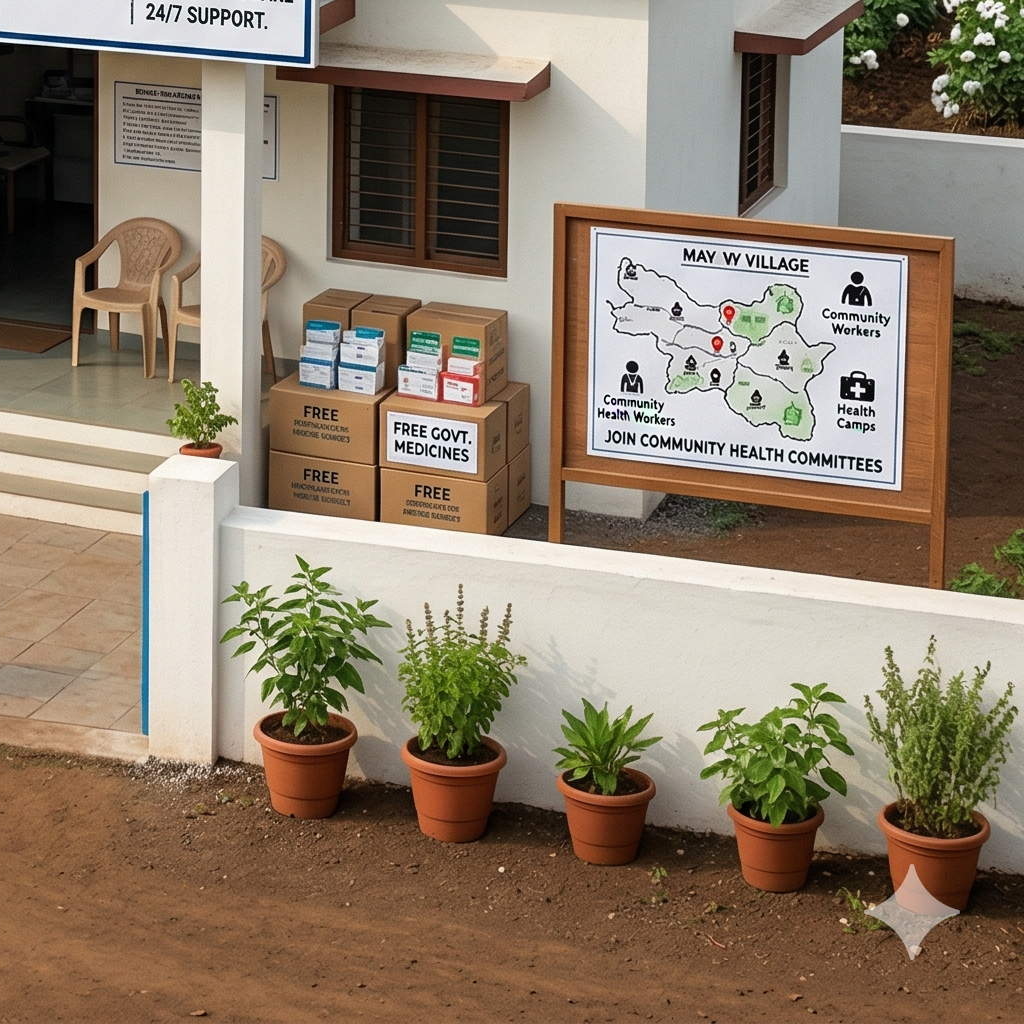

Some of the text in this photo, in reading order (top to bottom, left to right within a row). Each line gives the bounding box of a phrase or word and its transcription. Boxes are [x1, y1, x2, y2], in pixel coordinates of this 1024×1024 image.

[146, 3, 267, 29] 24/7 SUPPORT.
[684, 248, 715, 263] MAY
[745, 254, 809, 273] VILLAGE
[822, 308, 890, 327] Community
[832, 323, 880, 338] Workers
[603, 395, 664, 413] Community
[838, 404, 875, 417] Health
[304, 406, 338, 421] FREE
[598, 408, 675, 426] Health Workers
[394, 422, 471, 444] FREE GOVT.
[837, 418, 875, 432] Camps
[395, 439, 469, 462] MEDICINES
[605, 430, 882, 474] JOIN COMMUNITY HEALTH COMMITTEES
[304, 469, 338, 484] FREE
[415, 485, 450, 501] FREE
